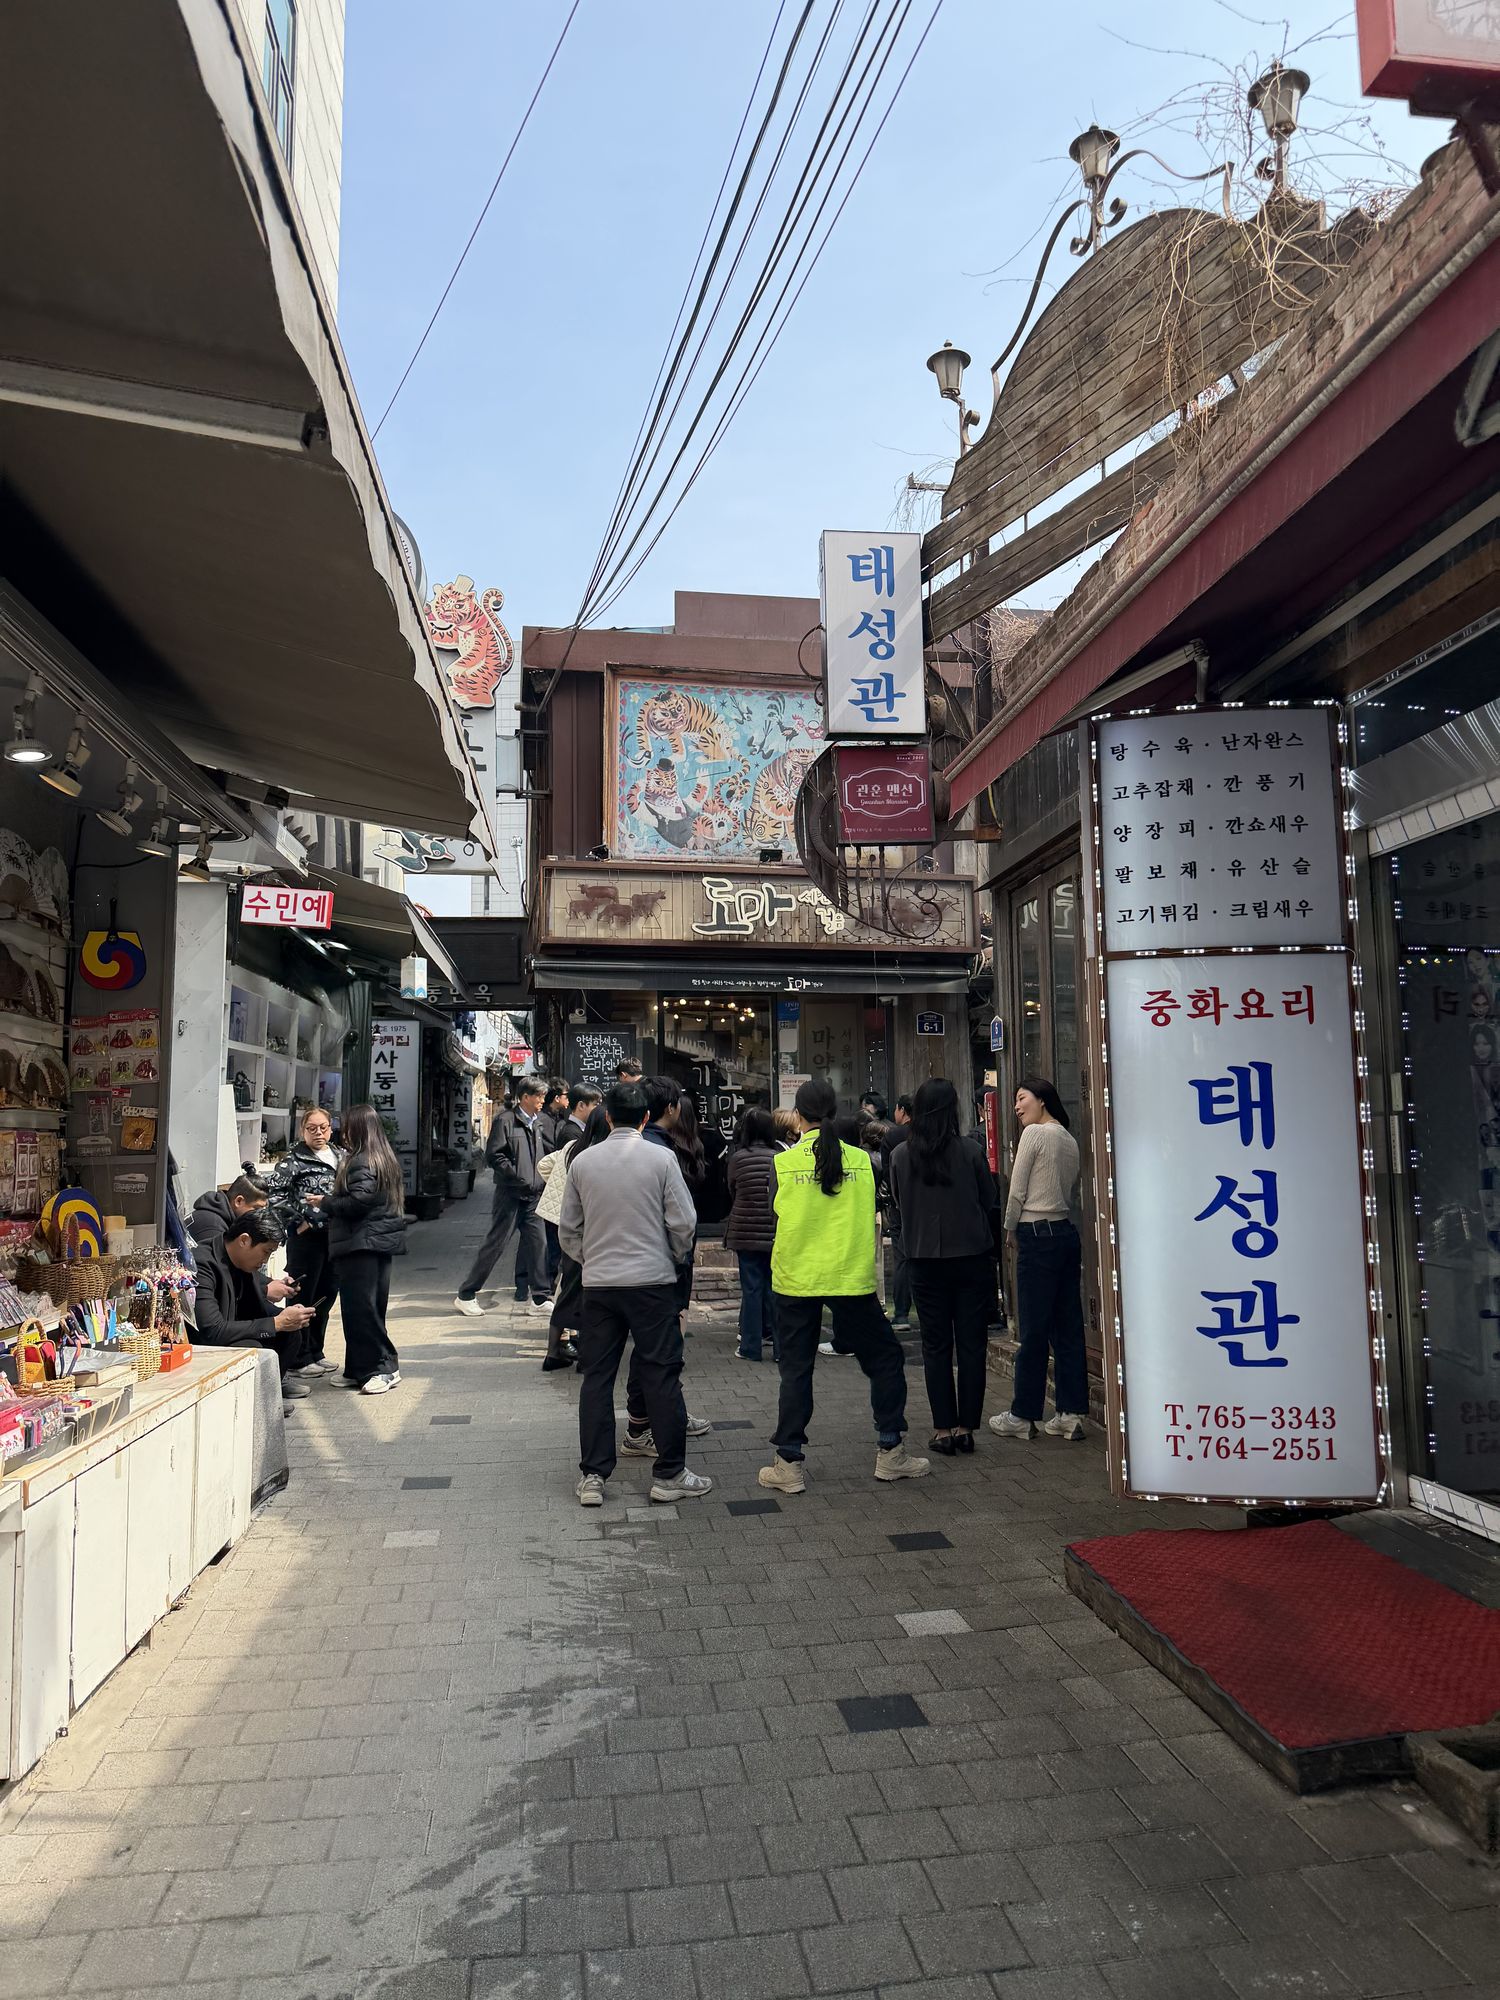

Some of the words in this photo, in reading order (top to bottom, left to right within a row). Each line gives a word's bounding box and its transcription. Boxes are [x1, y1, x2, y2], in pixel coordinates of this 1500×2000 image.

[847, 545, 907, 723] 태성관
[244, 888, 327, 924] 수민예
[1140, 984, 1315, 1028] 중화요리
[923, 1022, 938, 1032] 6-1
[1188, 1060, 1300, 1368] 태성관
[1164, 1403, 1338, 1431] T.765-3343
[1165, 1435, 1339, 1463] T.764-2551
